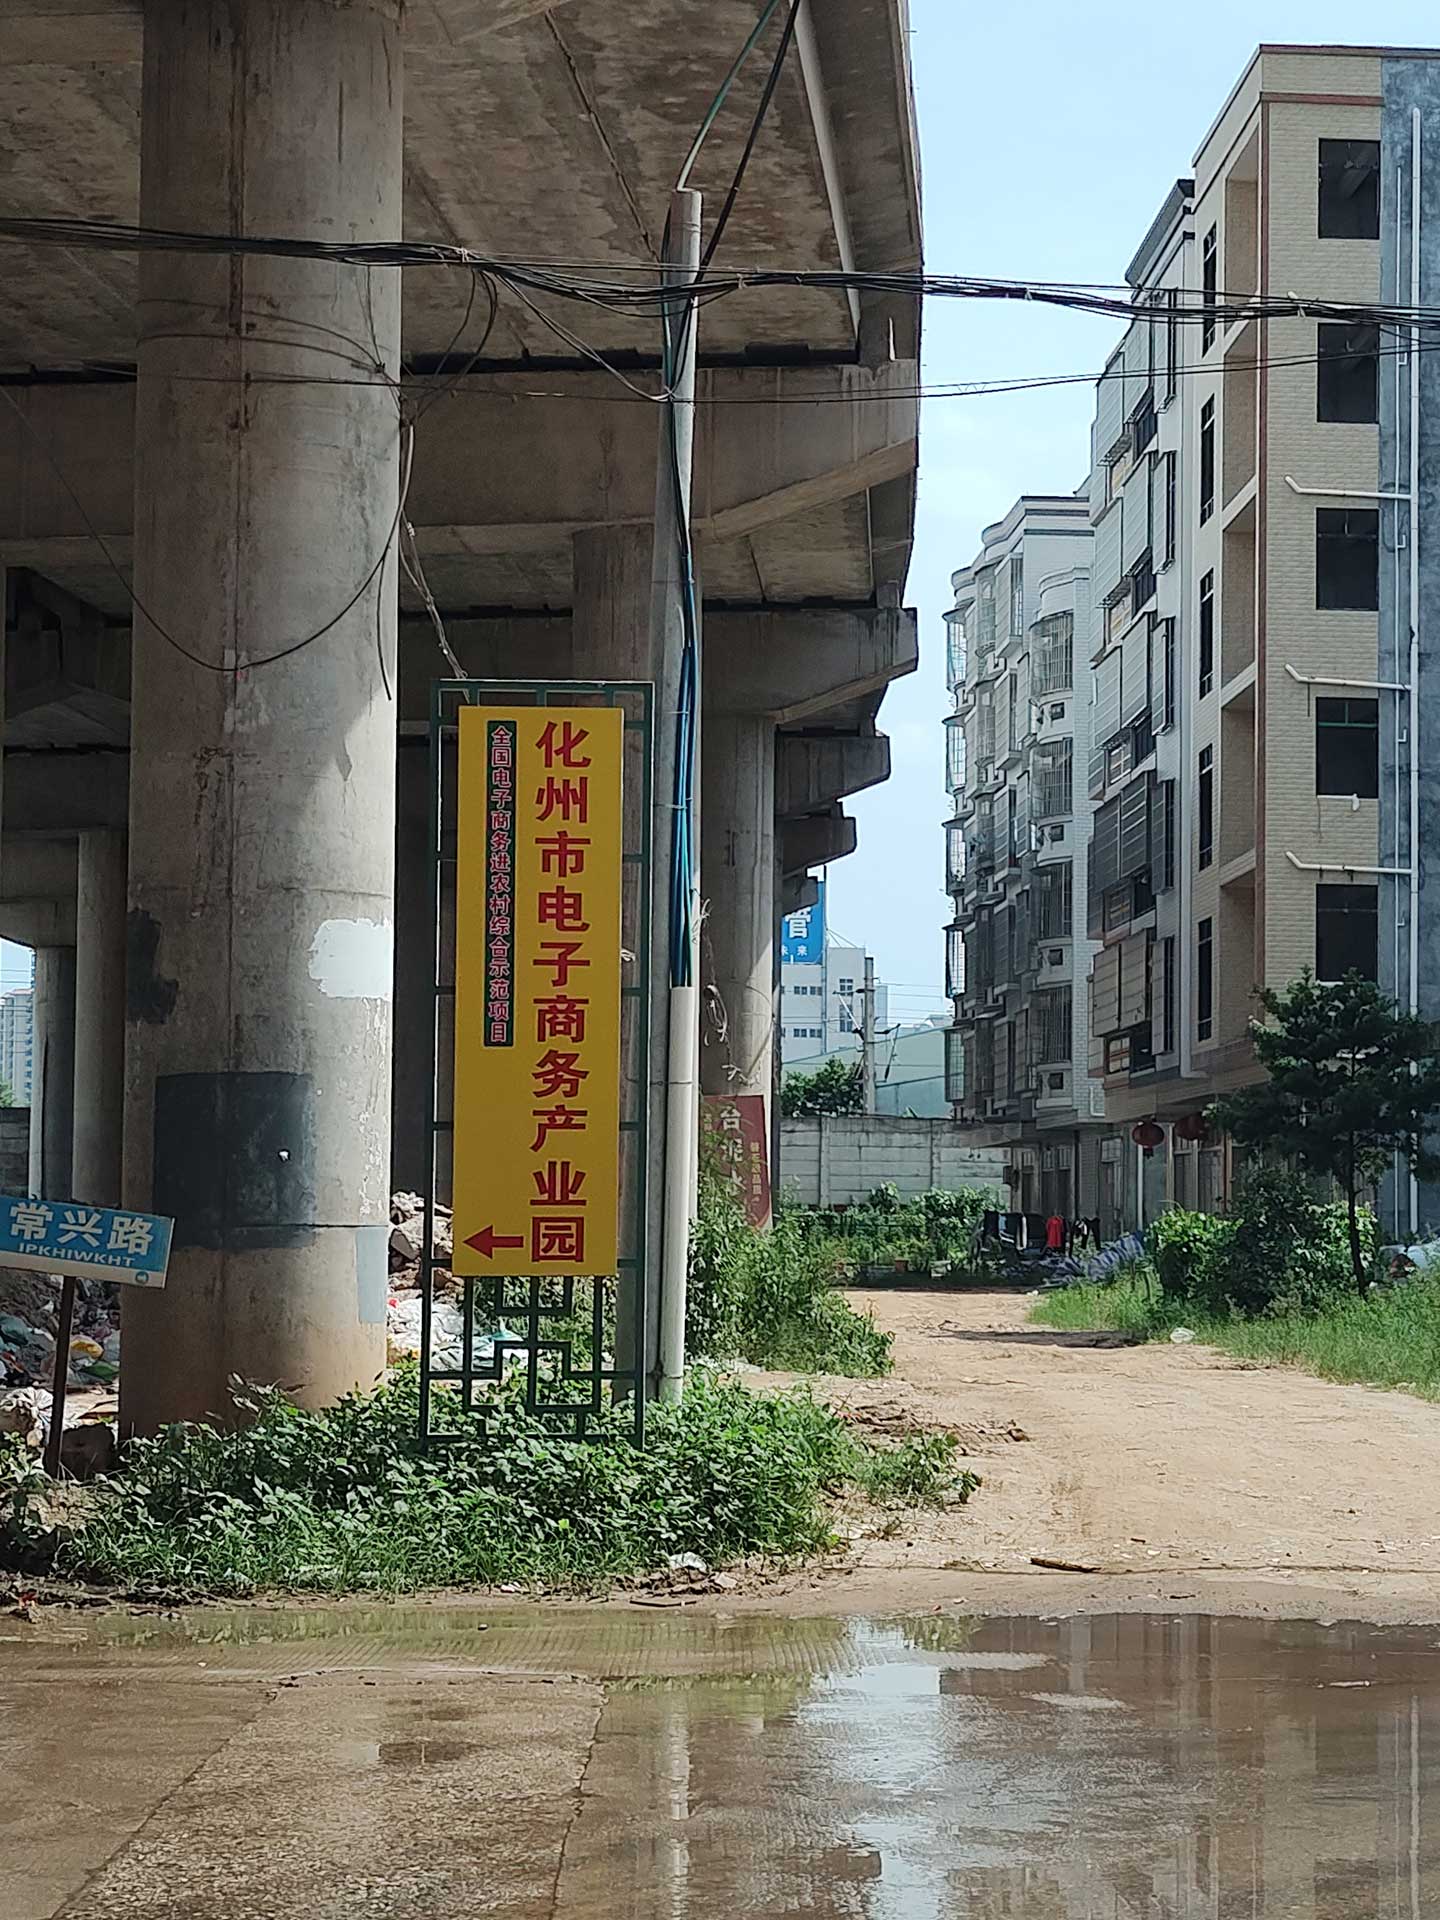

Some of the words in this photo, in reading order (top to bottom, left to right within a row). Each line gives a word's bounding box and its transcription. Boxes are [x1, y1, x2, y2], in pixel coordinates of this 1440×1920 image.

[488, 725, 512, 1043] 全国电子商务进农村综合示范项目
[530, 721, 592, 1262] 化州市电子商务产业园
[9, 1202, 154, 1257] 常兴路
